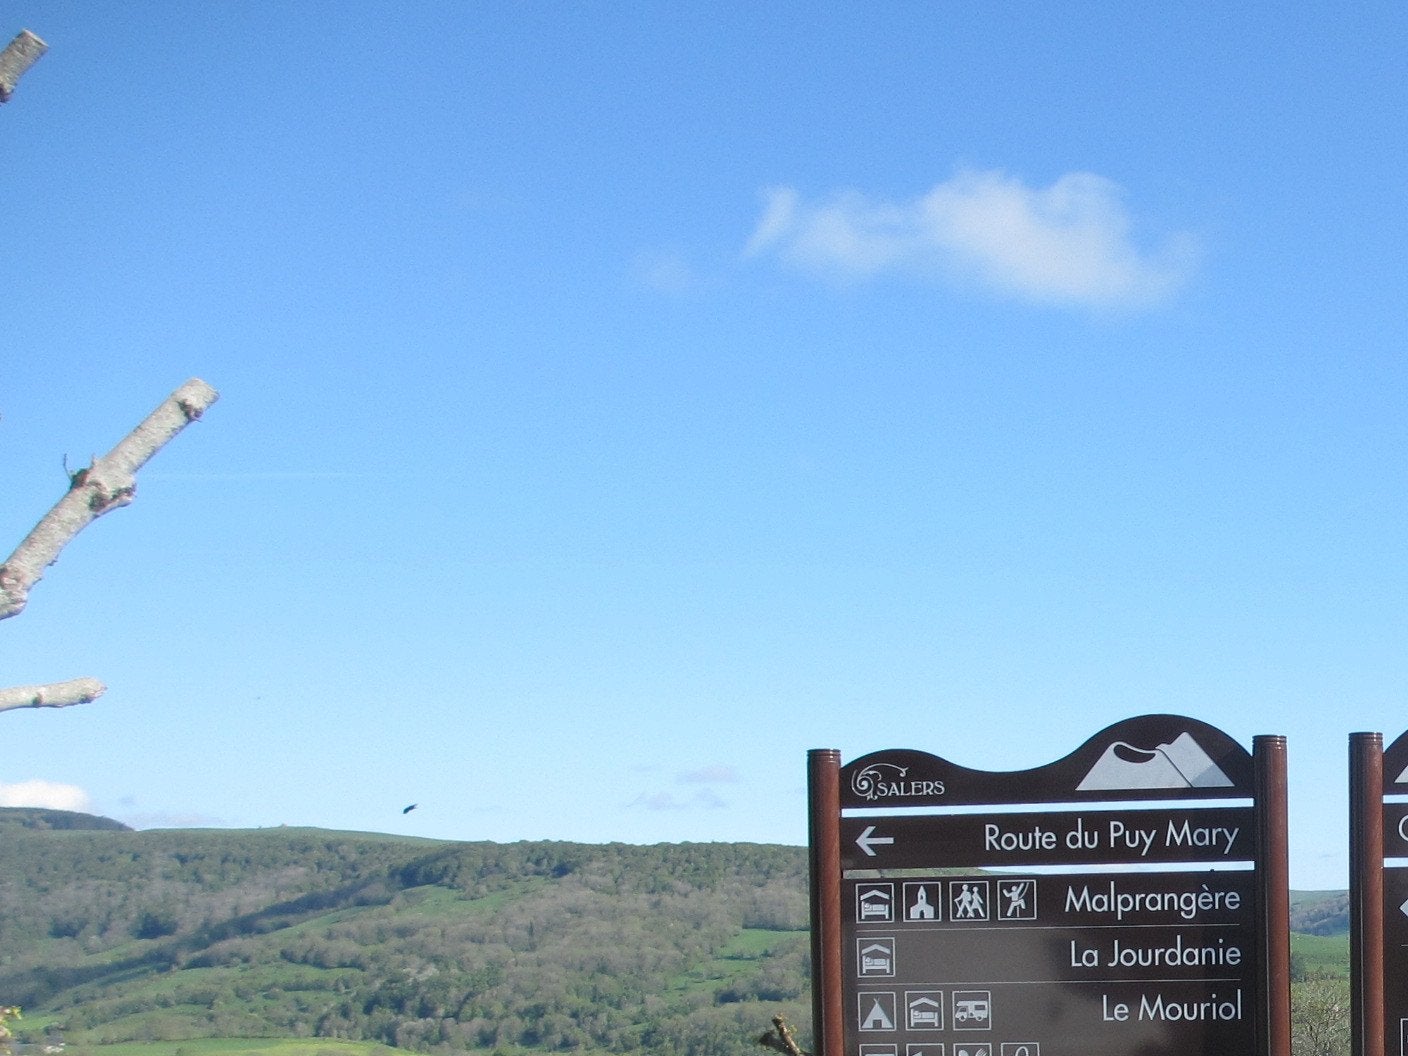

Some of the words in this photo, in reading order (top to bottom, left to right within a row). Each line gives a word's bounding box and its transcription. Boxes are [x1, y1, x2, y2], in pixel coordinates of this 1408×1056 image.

[877, 780, 945, 797] SALERS
[985, 823, 1057, 851] Route
[1065, 817, 1098, 849] du
[1109, 820, 1157, 856] Puy
[1165, 819, 1239, 855] Mary
[1064, 882, 1240, 920] Malprangère
[1070, 940, 1099, 968] La
[1107, 934, 1241, 968] Jourdanie
[1102, 994, 1130, 1022] Le
[1137, 988, 1242, 1021] Mouriol
